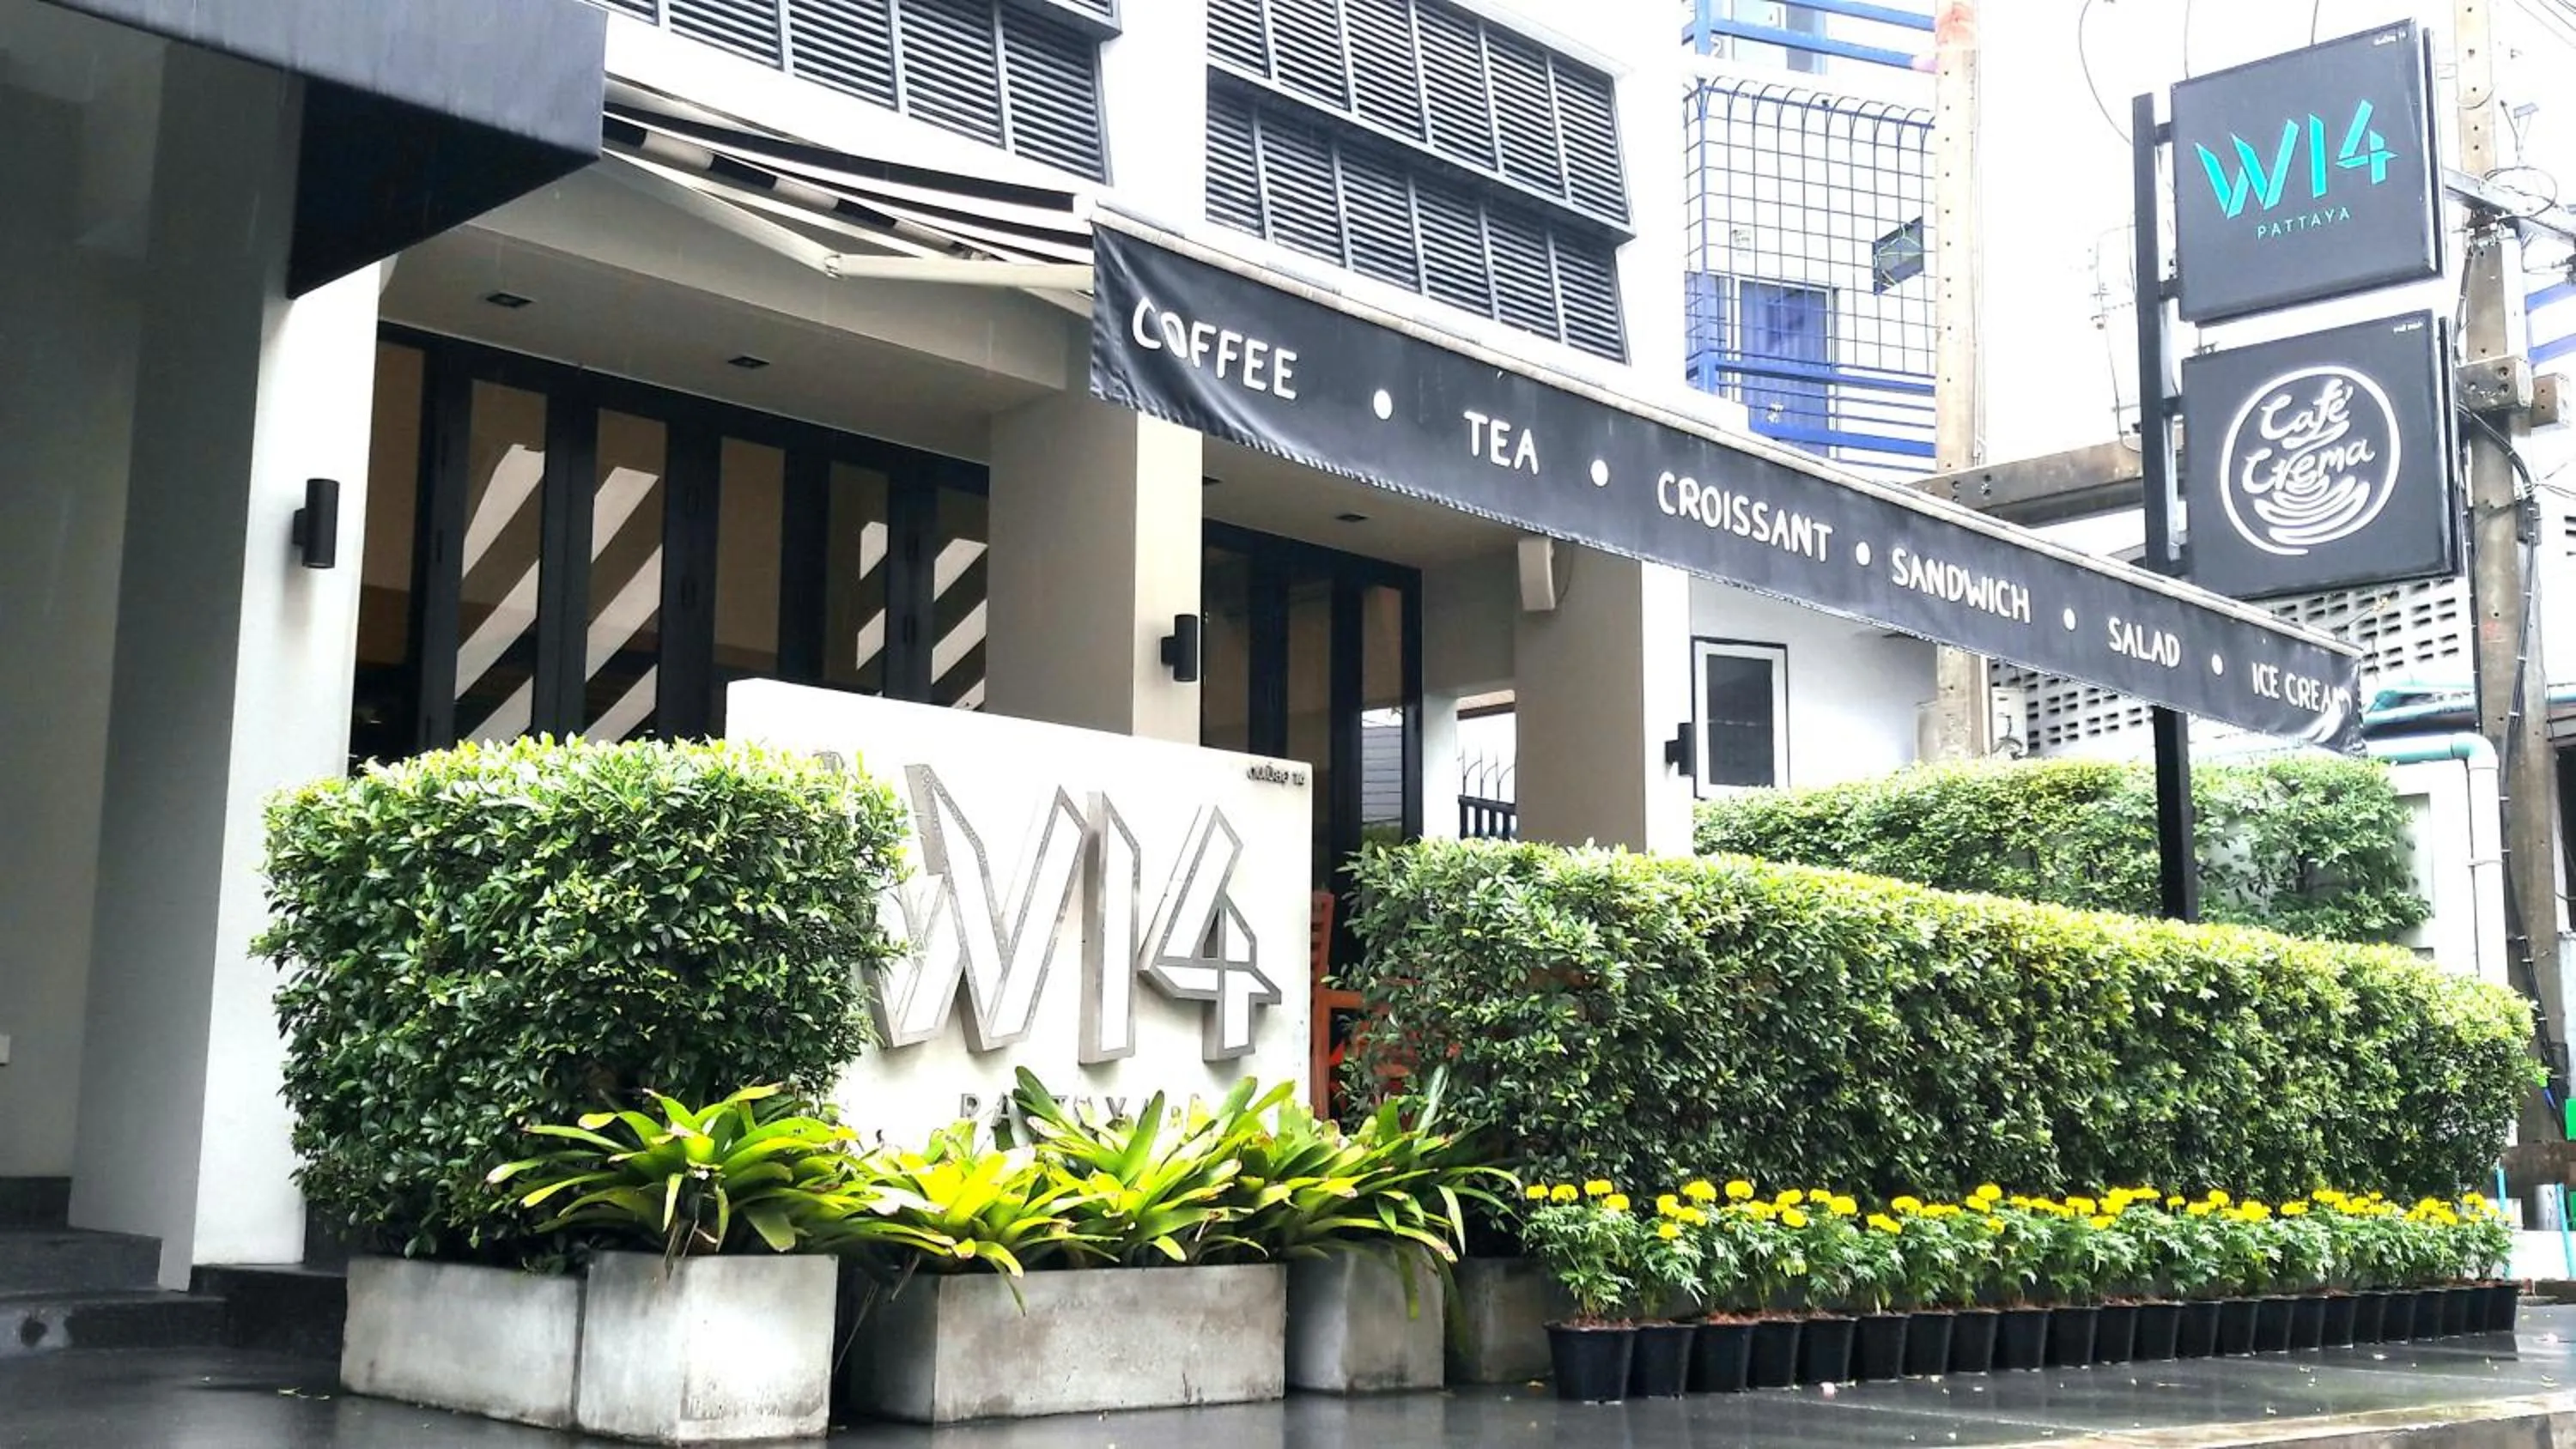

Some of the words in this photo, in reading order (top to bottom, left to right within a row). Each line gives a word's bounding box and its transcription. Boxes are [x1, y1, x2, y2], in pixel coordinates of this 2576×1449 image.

[2257, 206, 2351, 240] PATTAYA
[2259, 378, 2354, 451] Café
[2241, 439, 2377, 494] Crema
[1132, 296, 1298, 401] COFFEE
[1463, 409, 1540, 475] TEA
[1656, 470, 1834, 562] CROISSANT
[1891, 547, 2032, 625] SANDWICH
[2107, 615, 2182, 669] SALAD
[2251, 662, 2281, 700] ICE
[2284, 672, 2353, 716] CREAM
[959, 1091, 1161, 1130] PATY
